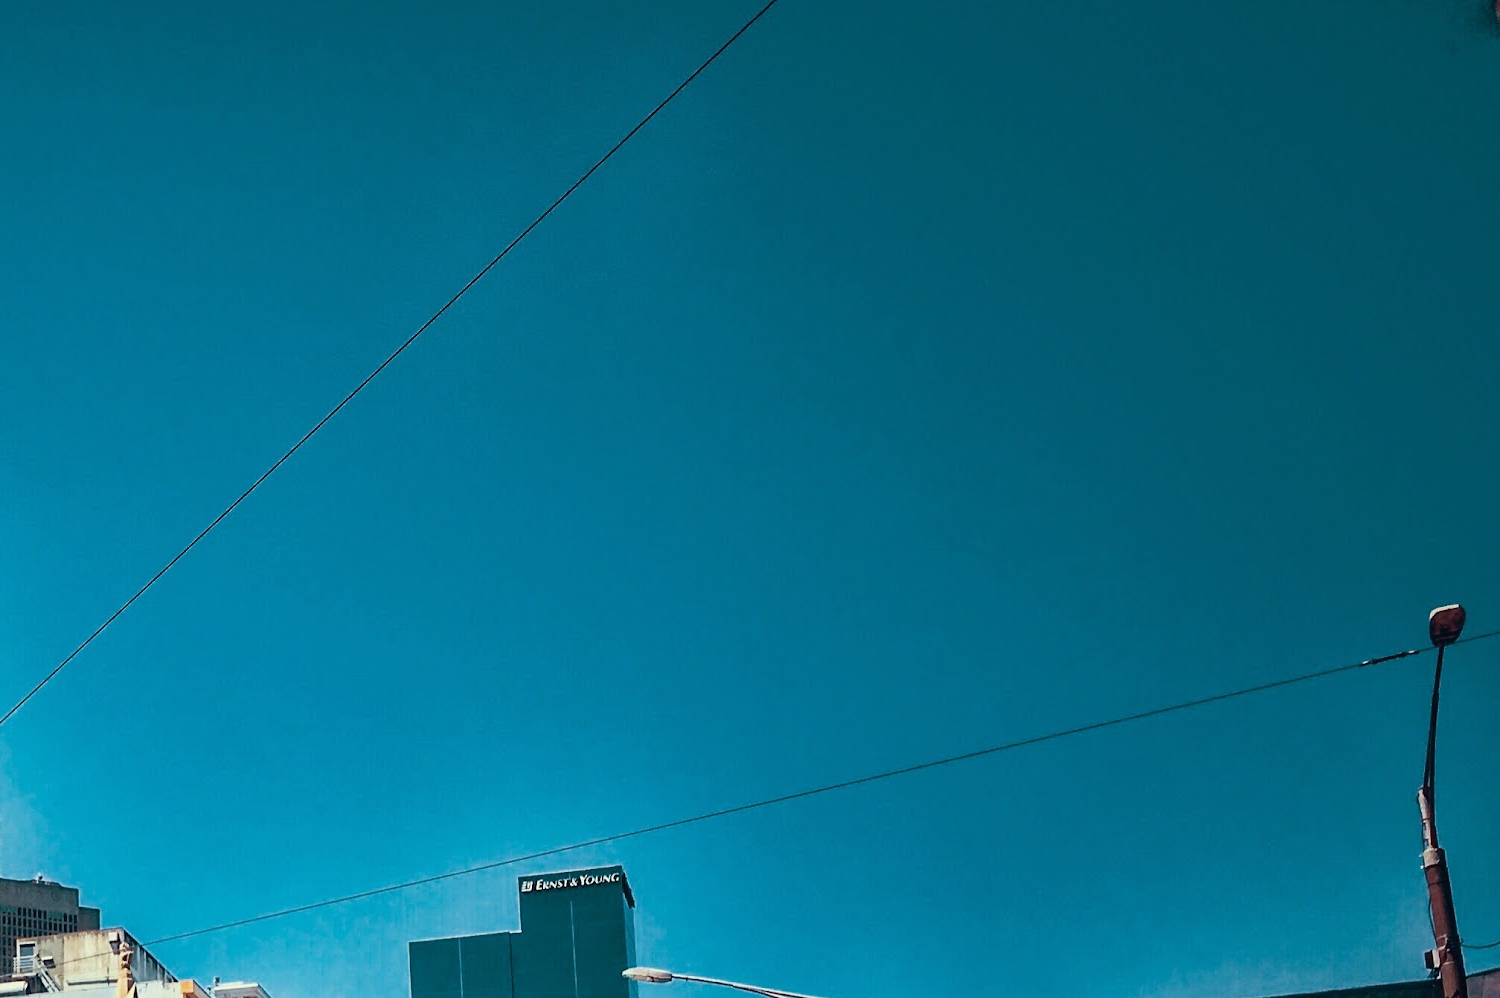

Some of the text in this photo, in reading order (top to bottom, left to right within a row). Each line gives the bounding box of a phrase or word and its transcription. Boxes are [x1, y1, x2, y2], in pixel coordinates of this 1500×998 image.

[536, 878, 568, 891] ERNST
[569, 877, 578, 887] &
[579, 872, 620, 886] YOUNG
